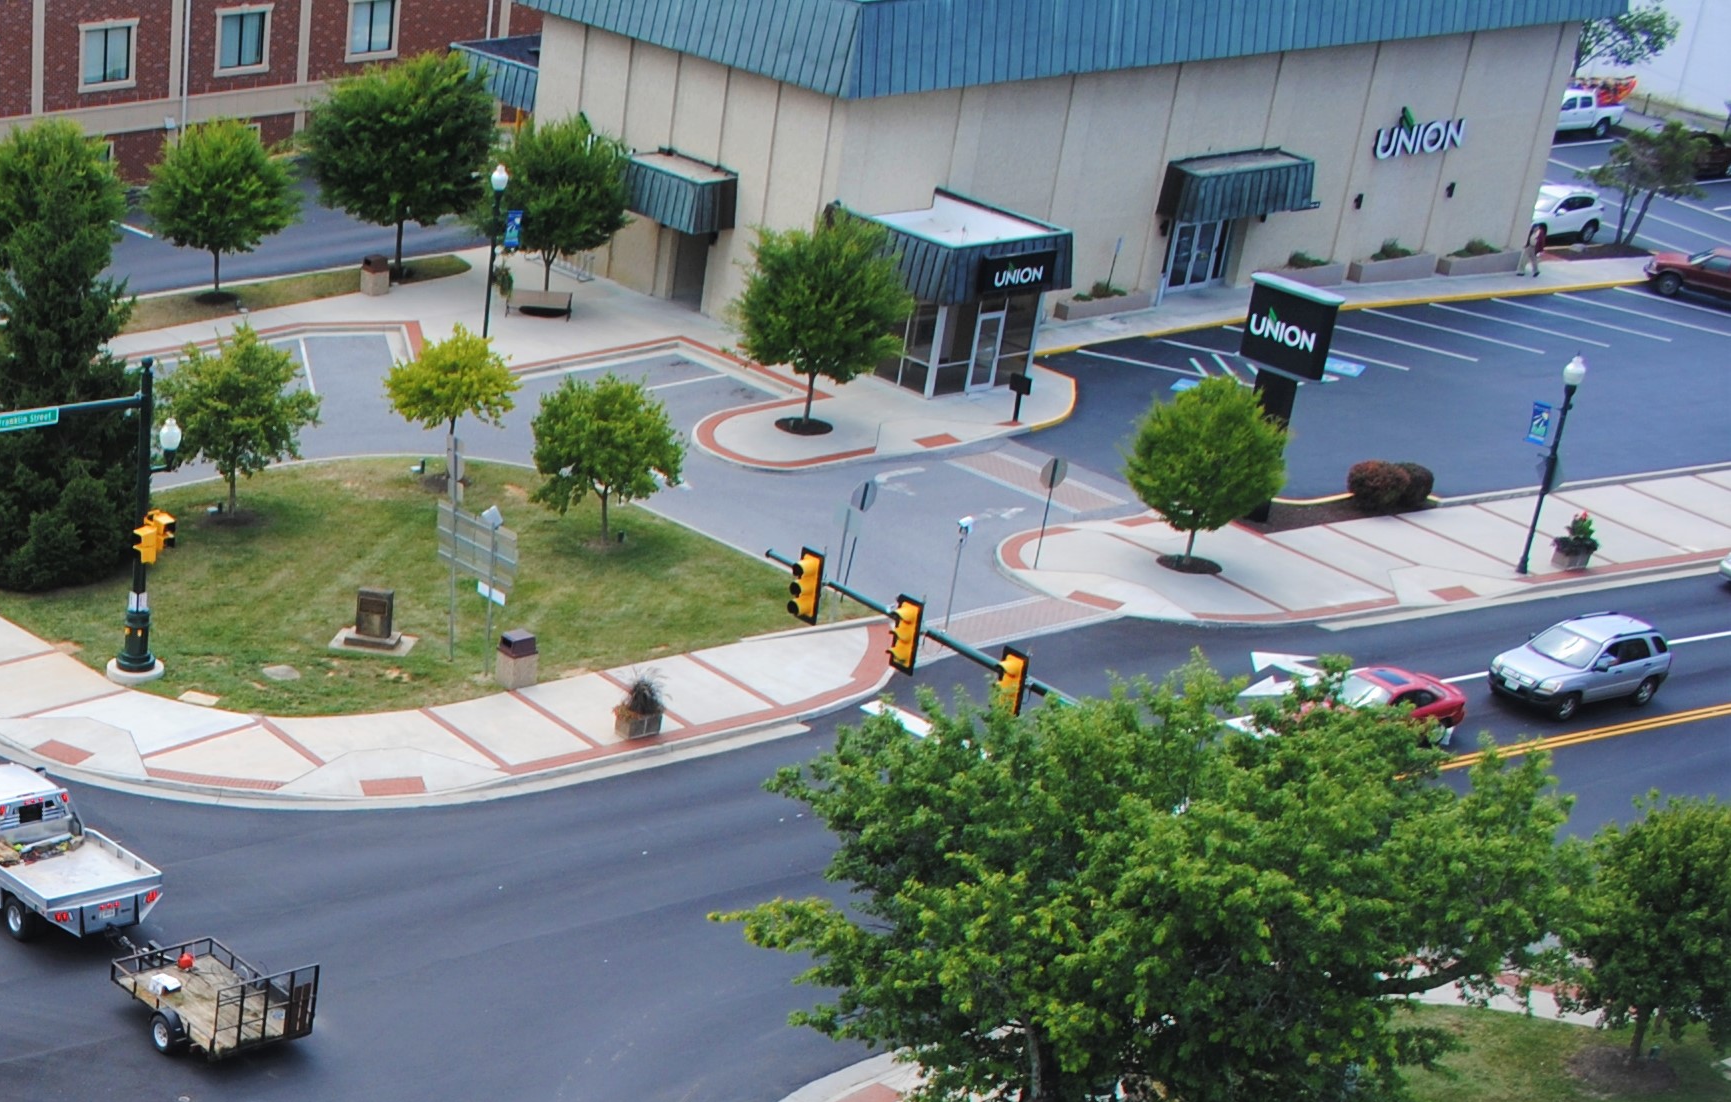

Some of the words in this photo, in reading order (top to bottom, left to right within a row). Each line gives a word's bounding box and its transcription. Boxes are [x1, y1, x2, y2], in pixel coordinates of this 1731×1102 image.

[1374, 118, 1466, 160] UNION
[994, 264, 1044, 287] UNION
[1250, 313, 1316, 353] UNION
[30, 412, 52, 423] Street
